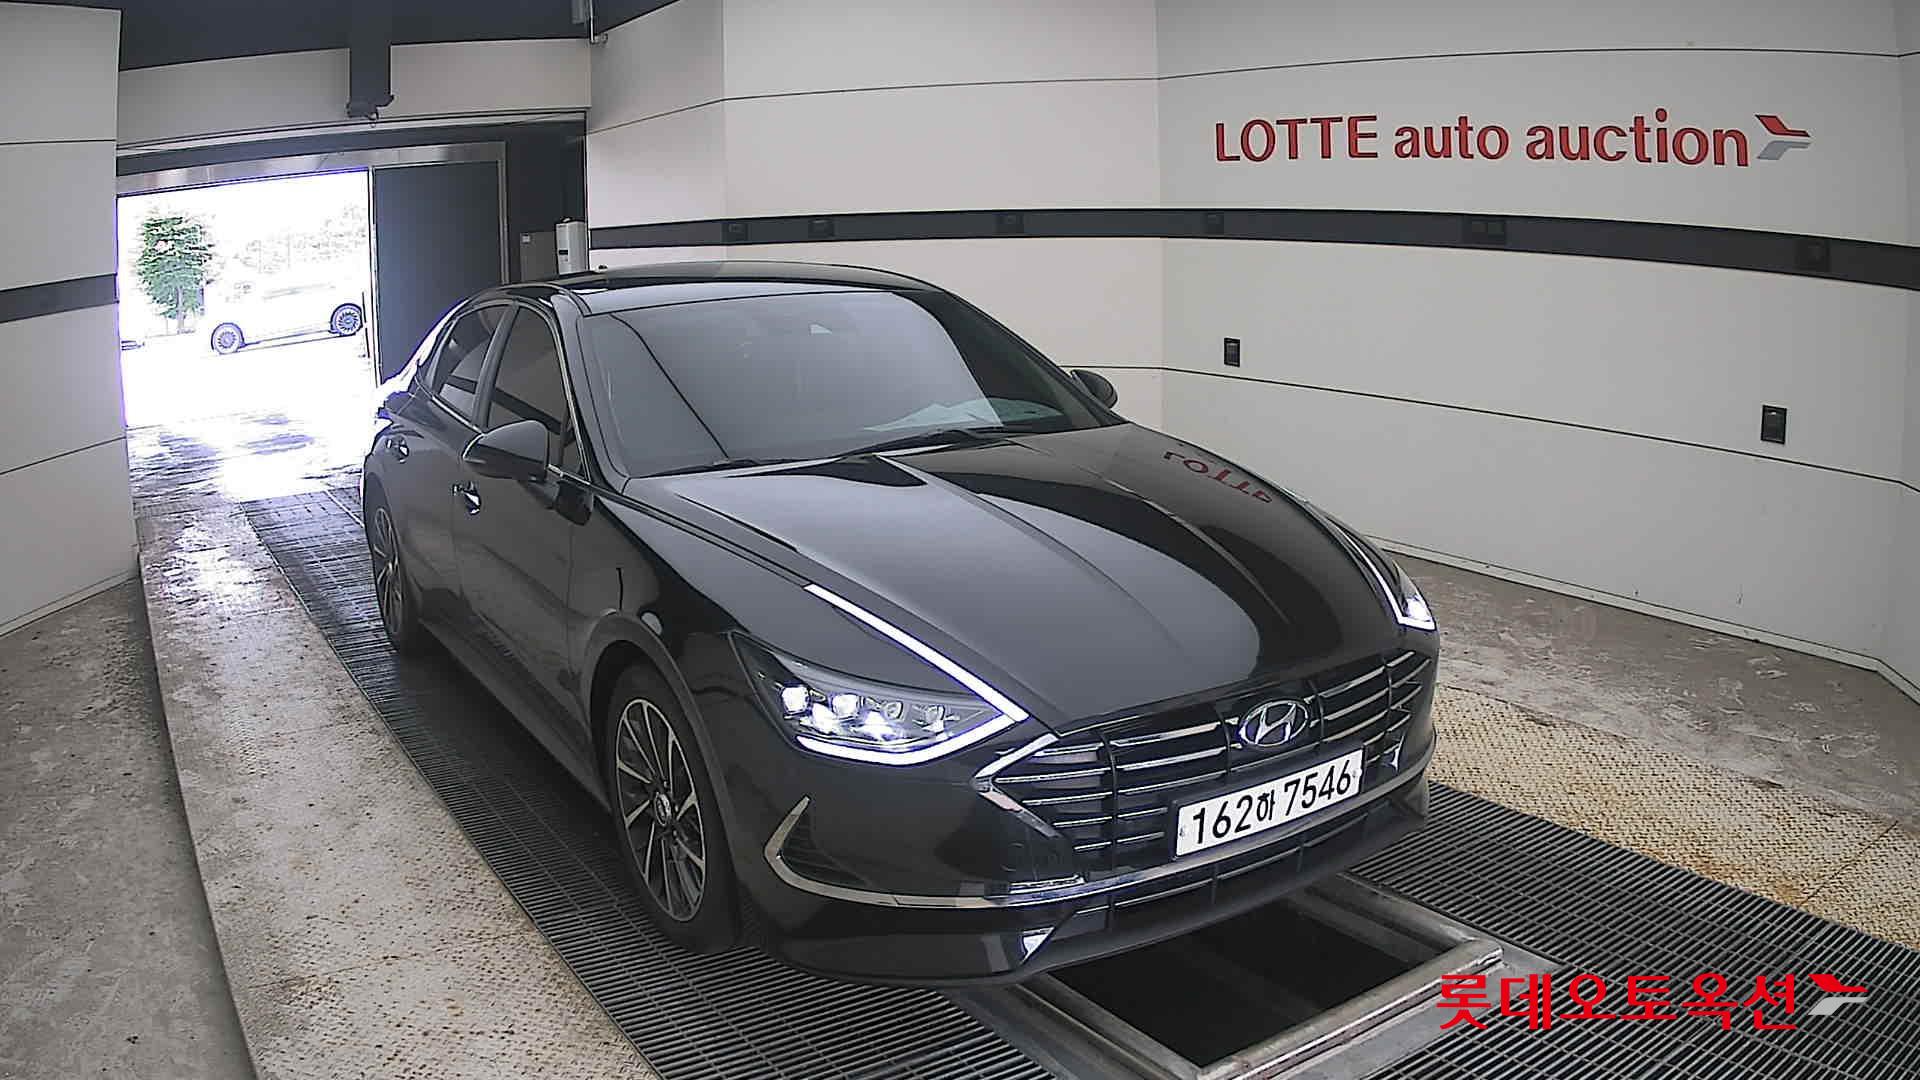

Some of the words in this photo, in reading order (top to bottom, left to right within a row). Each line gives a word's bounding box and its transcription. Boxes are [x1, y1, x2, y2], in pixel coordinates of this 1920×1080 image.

[1215, 115, 1378, 162] LOTTE
[1394, 115, 1510, 160] auto
[1526, 108, 1750, 167] auction
[1192, 789, 1276, 844] 162하
[1283, 759, 1351, 817] 7546
